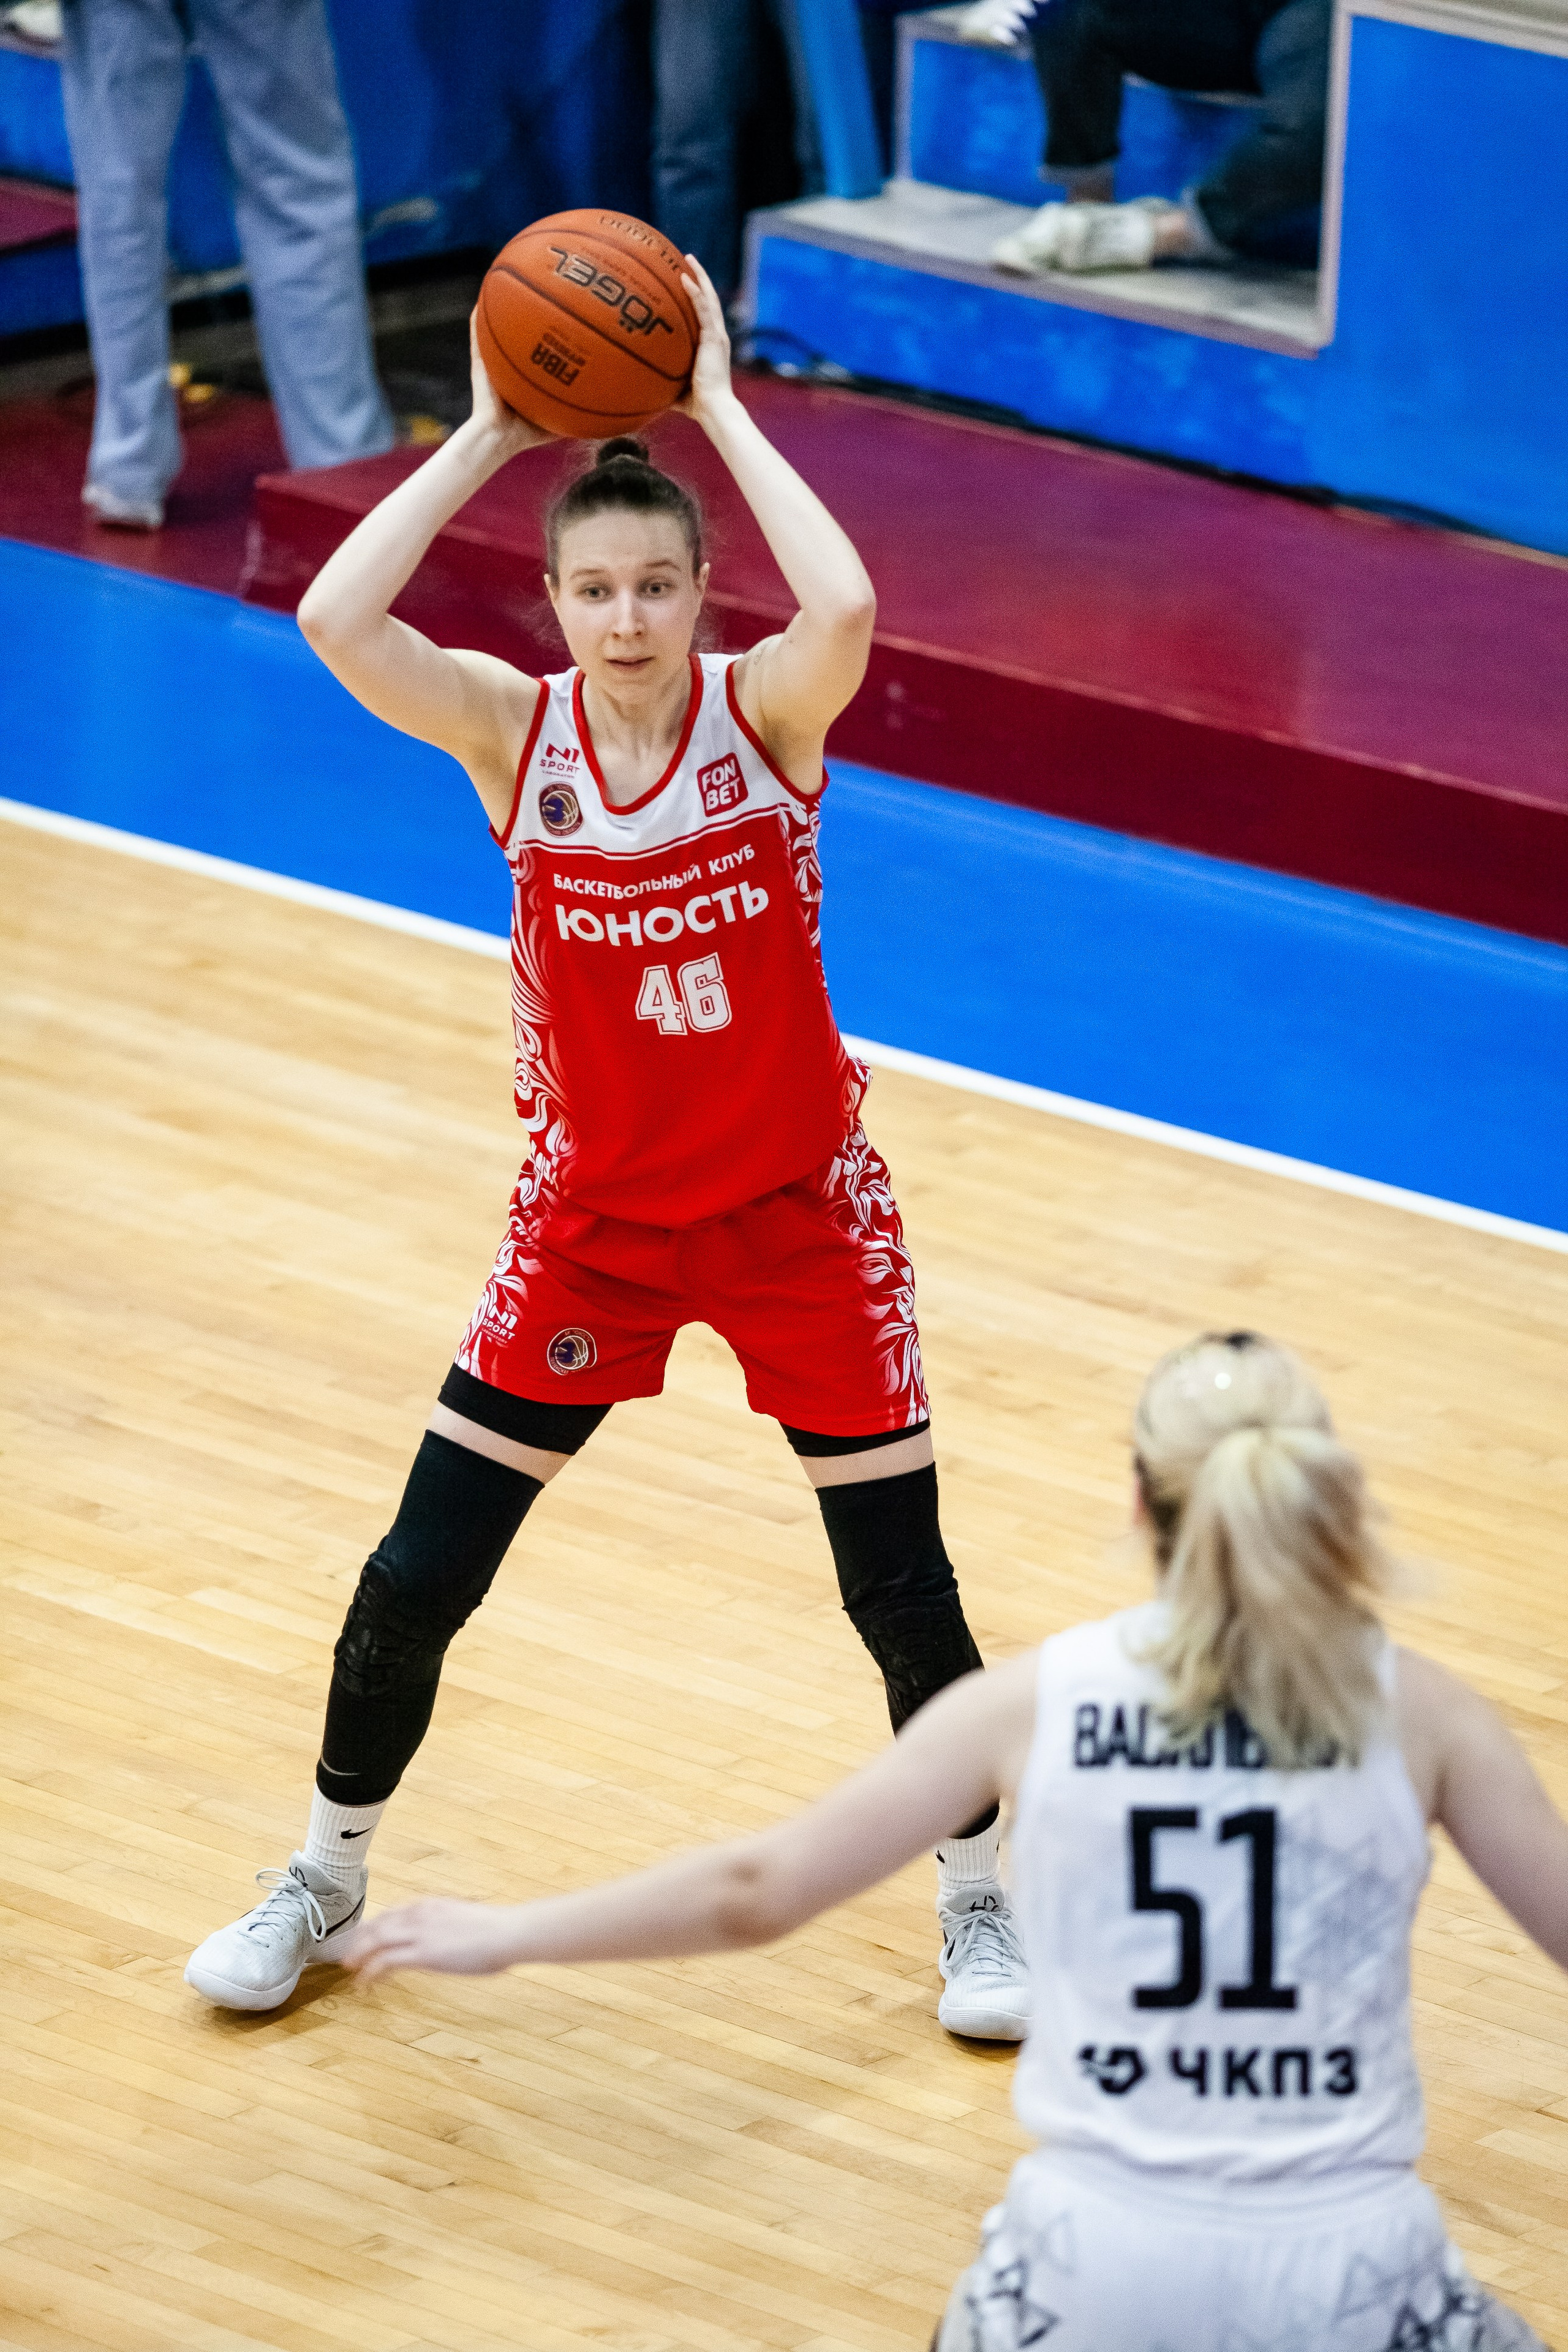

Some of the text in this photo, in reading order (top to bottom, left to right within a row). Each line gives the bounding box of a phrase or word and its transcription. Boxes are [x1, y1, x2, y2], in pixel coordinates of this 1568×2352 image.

[550, 246, 673, 334] JÖGEL
[531, 342, 579, 386] FIBA
[540, 759, 580, 774] SPORT
[702, 759, 736, 792] FON
[706, 777, 741, 810] BET
[553, 844, 755, 900] БАСКЕТБОЛЬНЫЙ КЛУБ
[555, 880, 769, 946] ЮНОСТЬ
[635, 952, 732, 1036] 46
[482, 1317, 516, 1340] SPORT
[1129, 1806, 1297, 2010] 51
[1169, 2046, 1359, 2097] ЧКПЗ
